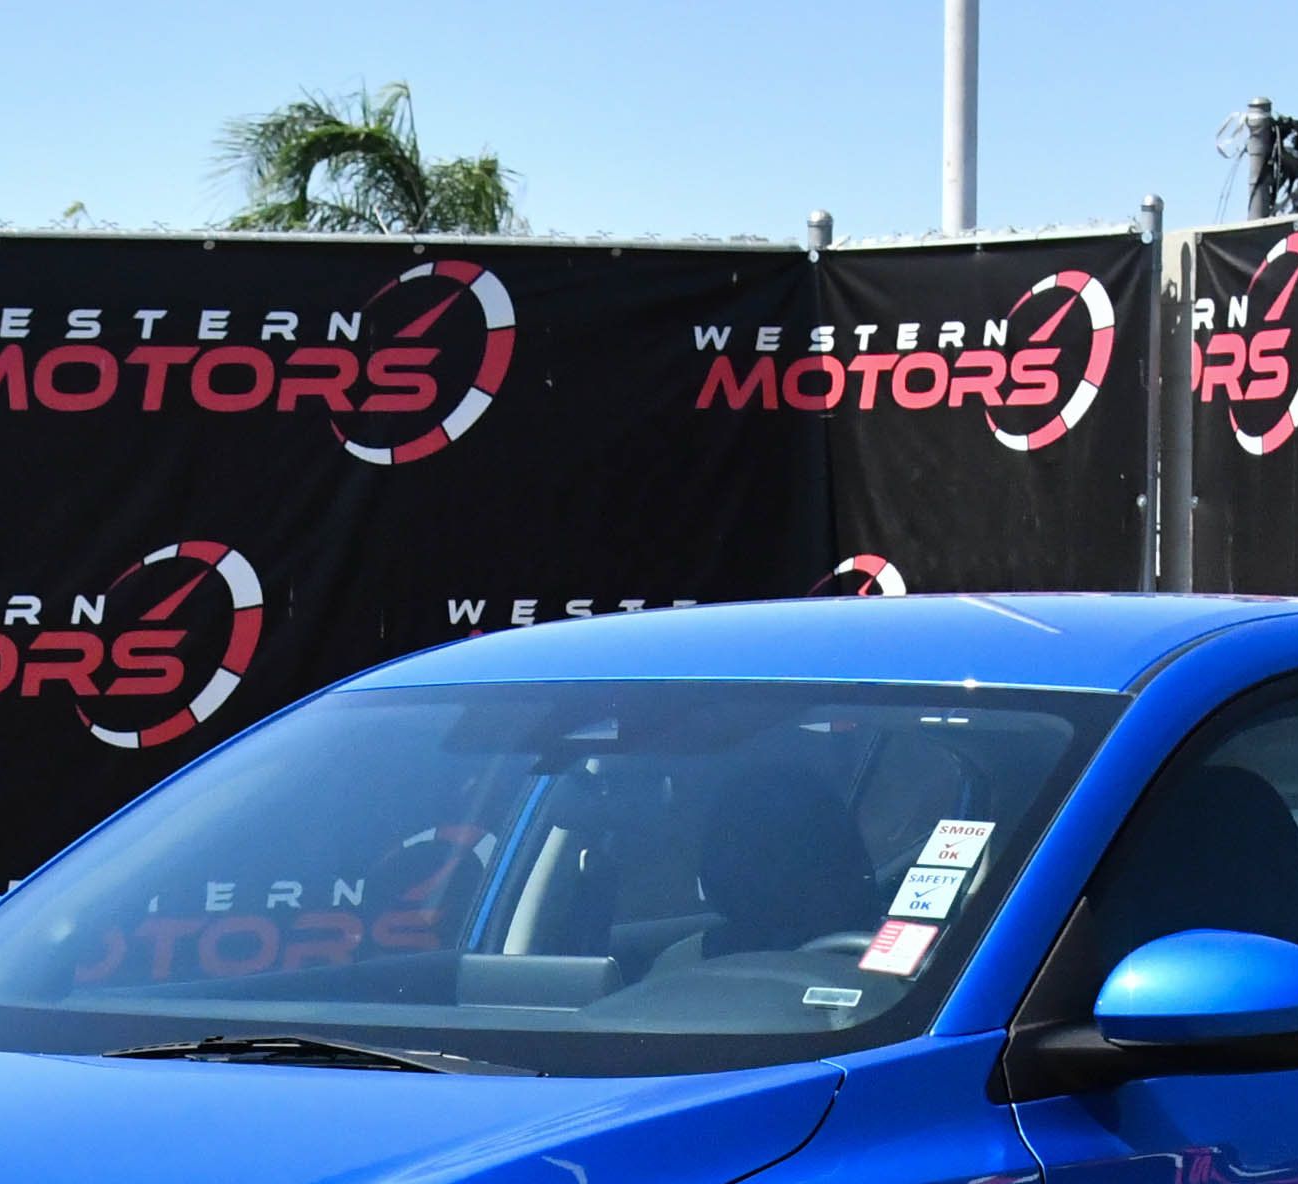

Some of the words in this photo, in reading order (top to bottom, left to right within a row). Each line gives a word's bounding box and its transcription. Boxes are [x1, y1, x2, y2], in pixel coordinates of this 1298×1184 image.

[694, 318, 1009, 353] WESTERN
[695, 346, 1062, 411] MOTORS
[938, 825, 986, 837] SMOG
[938, 850, 959, 861] OK
[908, 873, 959, 886] SAFETY
[909, 900, 933, 911] OK
